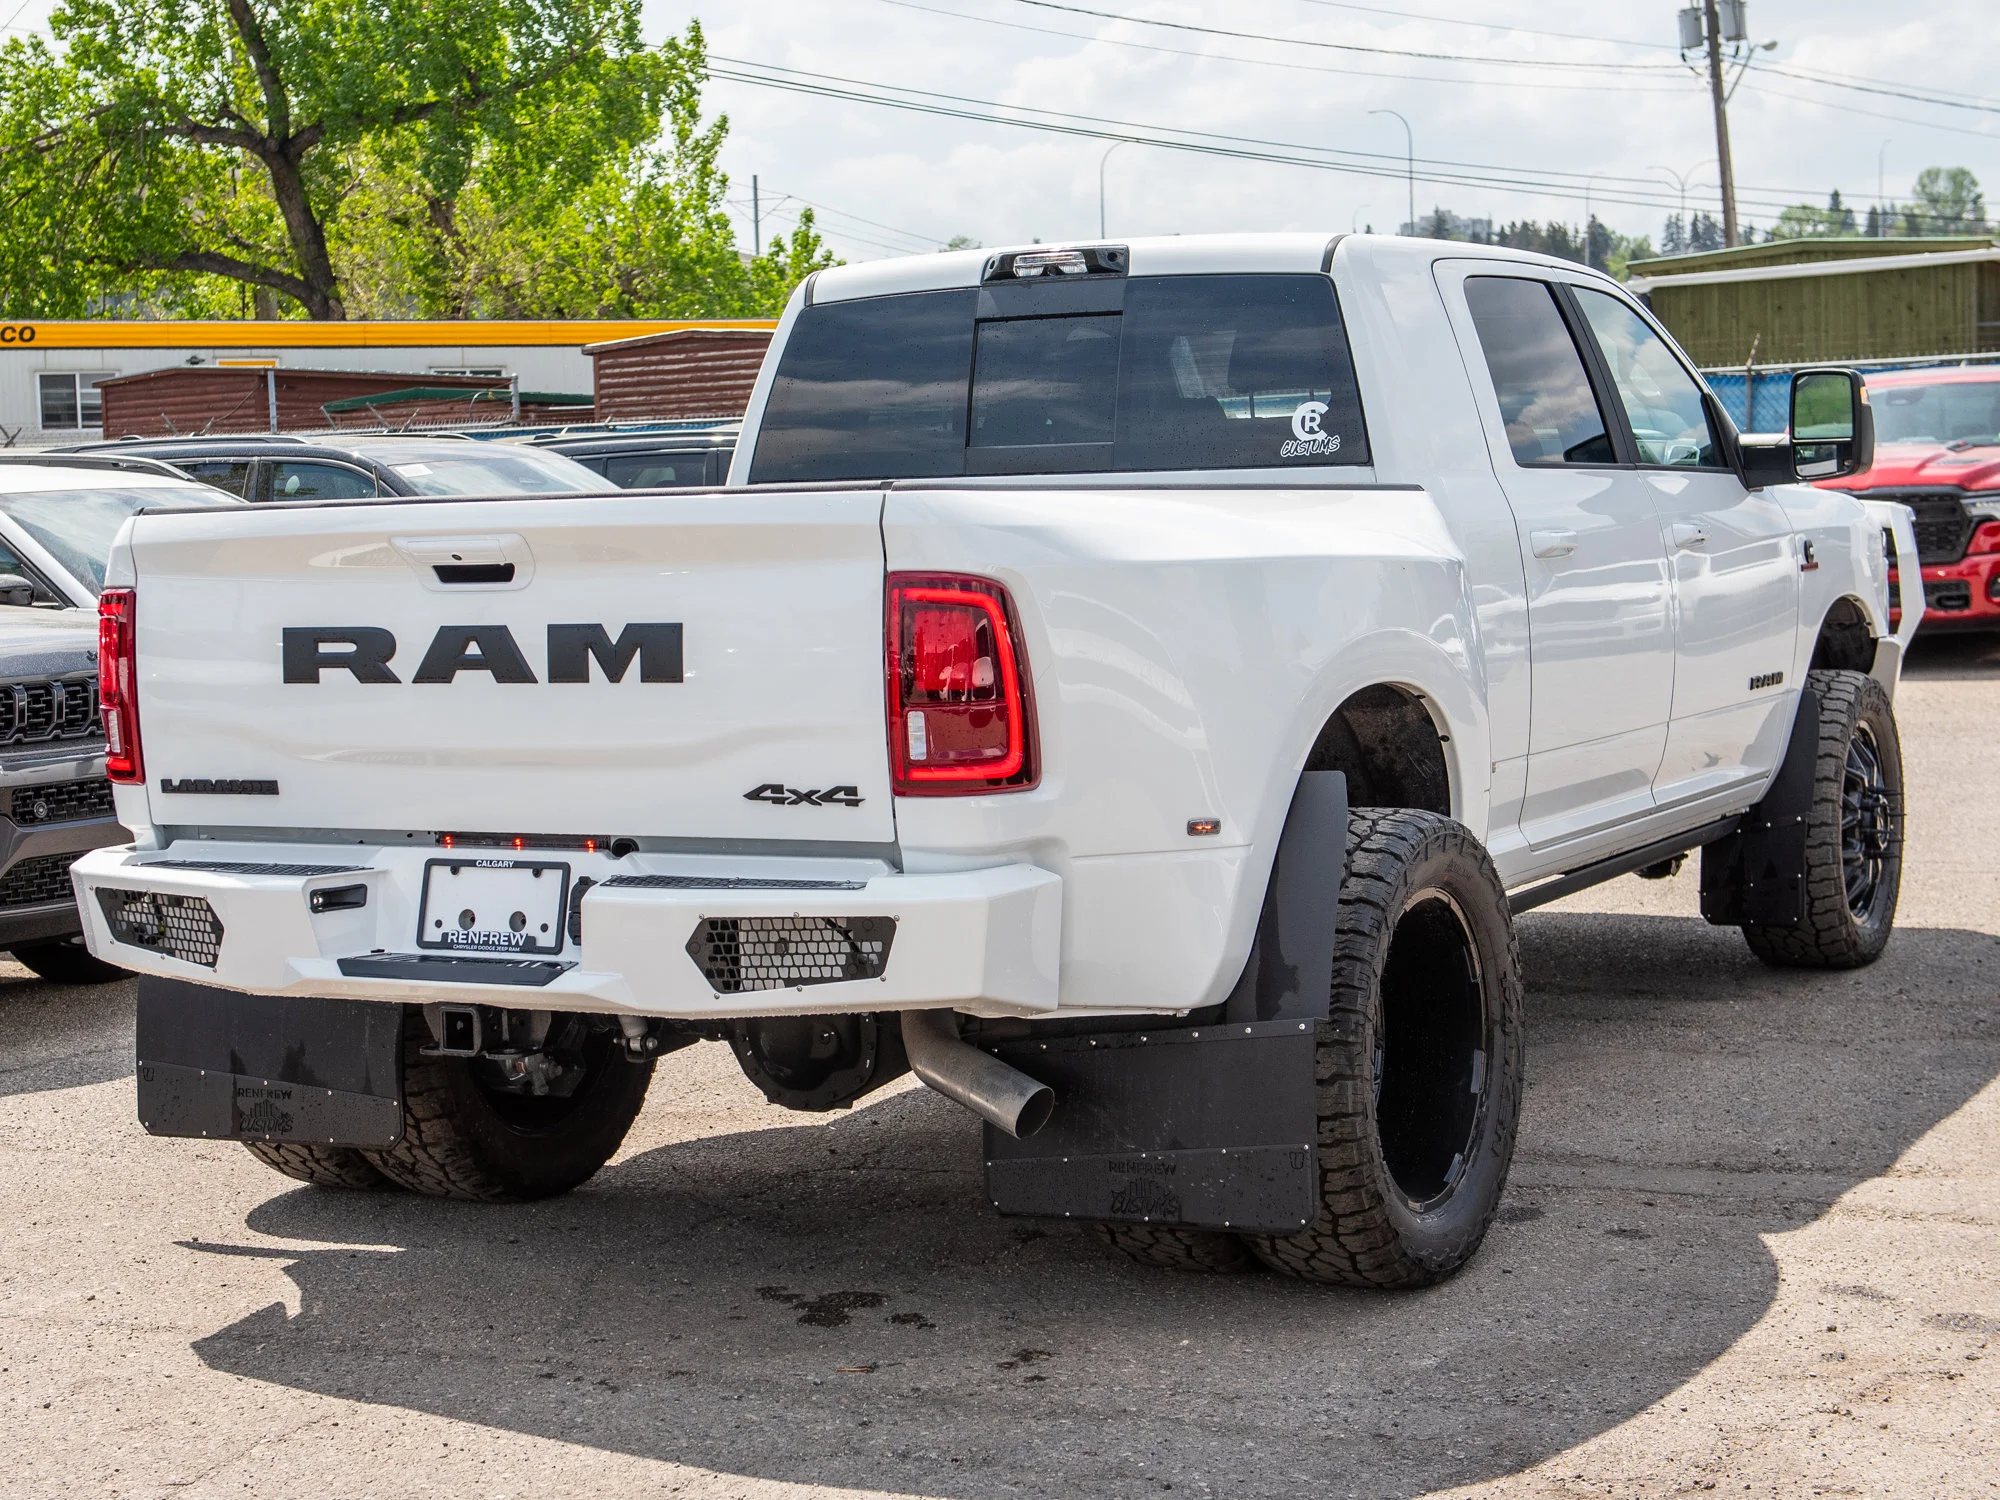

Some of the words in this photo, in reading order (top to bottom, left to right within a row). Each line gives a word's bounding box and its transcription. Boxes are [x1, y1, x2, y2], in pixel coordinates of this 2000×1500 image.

[1280, 435, 1341, 457] CUSTOMS
[283, 622, 683, 684] RAM
[1748, 671, 1784, 690] RAM
[475, 859, 515, 869] CALGARY
[447, 930, 528, 947] RENFREW
[236, 1087, 293, 1099] RENFREW
[239, 1112, 294, 1136] CUSTOMS
[1108, 1160, 1177, 1176] RENFREW
